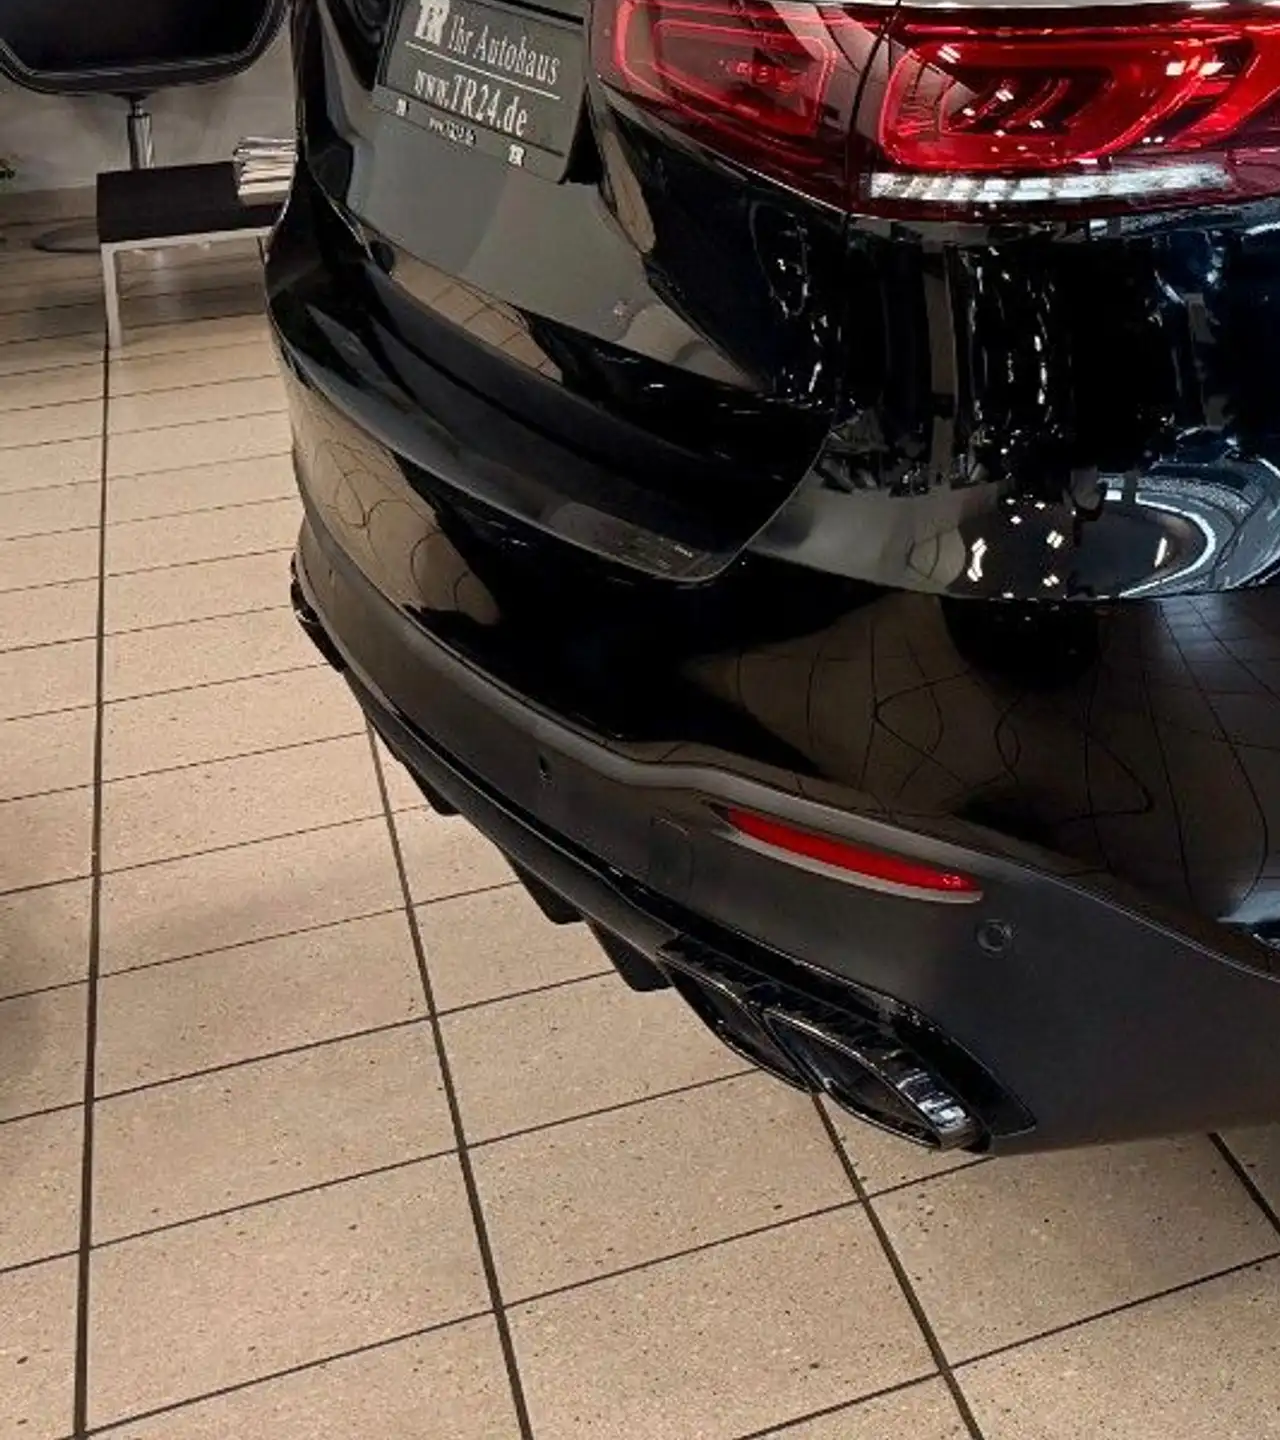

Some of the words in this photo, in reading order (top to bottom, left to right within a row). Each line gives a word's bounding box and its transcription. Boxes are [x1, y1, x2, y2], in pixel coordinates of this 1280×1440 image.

[446, 14, 475, 56] Ihr
[472, 24, 561, 86] Autohaus
[413, 68, 529, 138] www.TR24.de
